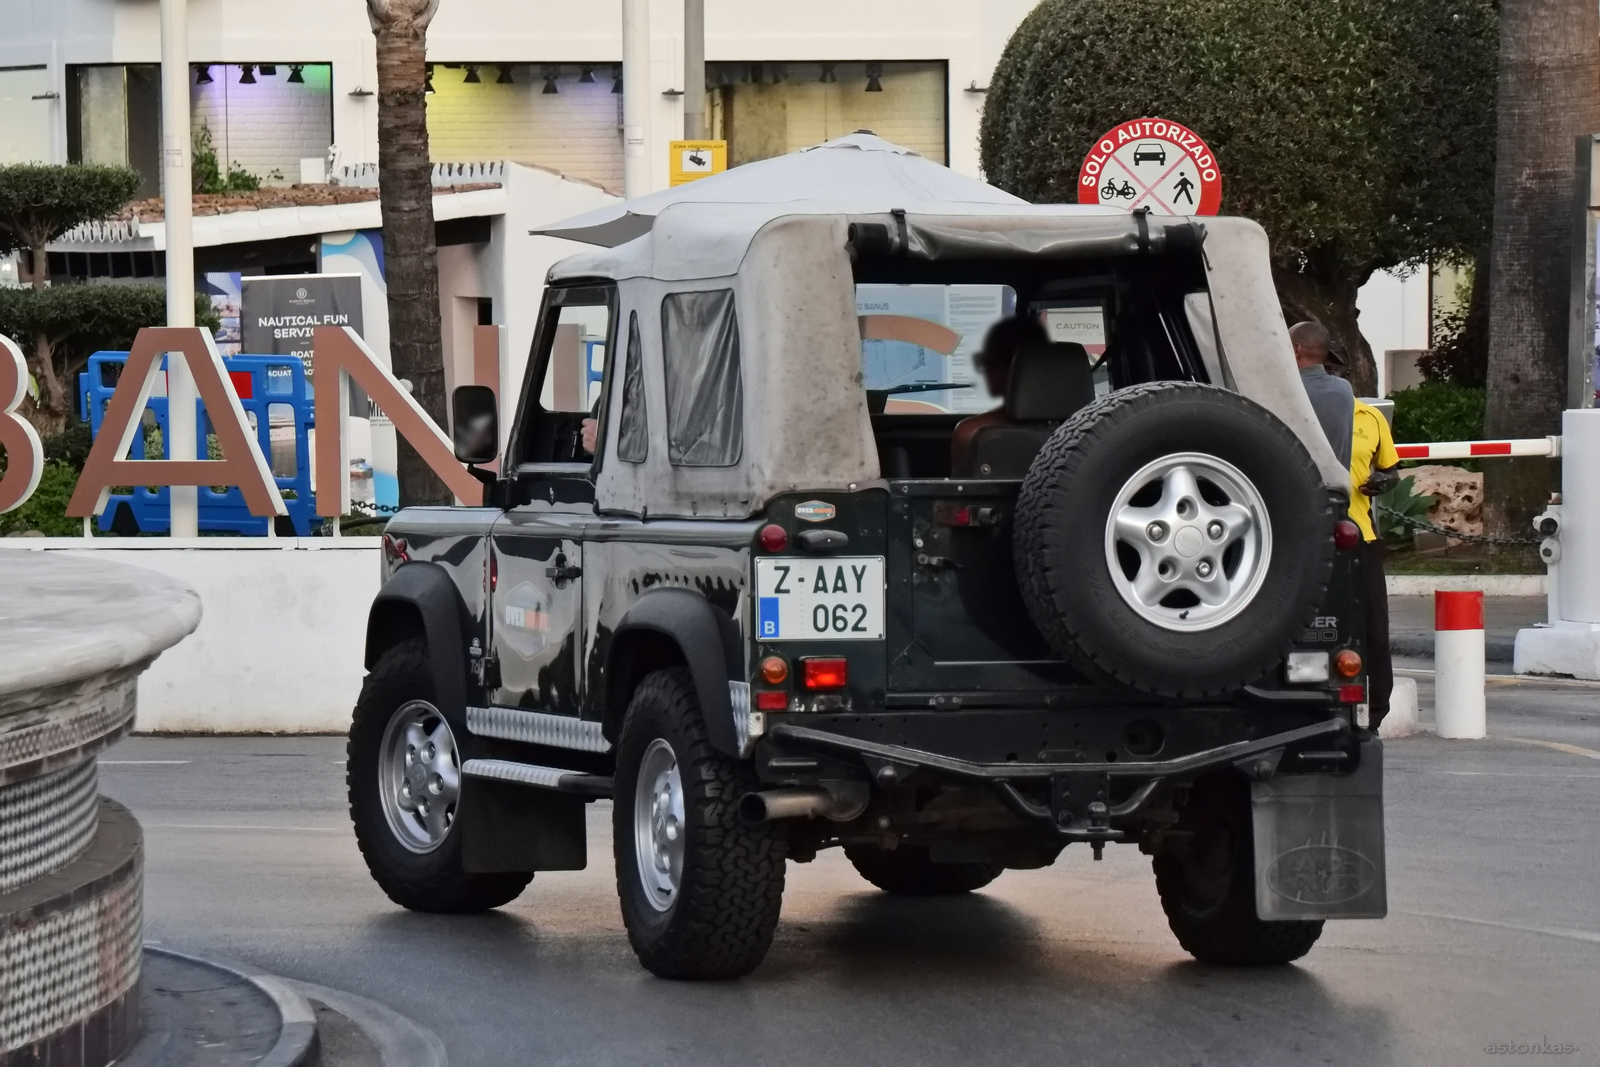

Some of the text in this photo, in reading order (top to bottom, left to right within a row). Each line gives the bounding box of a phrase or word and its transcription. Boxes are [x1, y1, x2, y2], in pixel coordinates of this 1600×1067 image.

[1082, 122, 1217, 187] SOLO AUTORIZADO
[258, 314, 348, 327] NAUTICAL FUN
[813, 603, 867, 633] 062
[1311, 616, 1337, 628] ER
[764, 621, 776, 634] B
